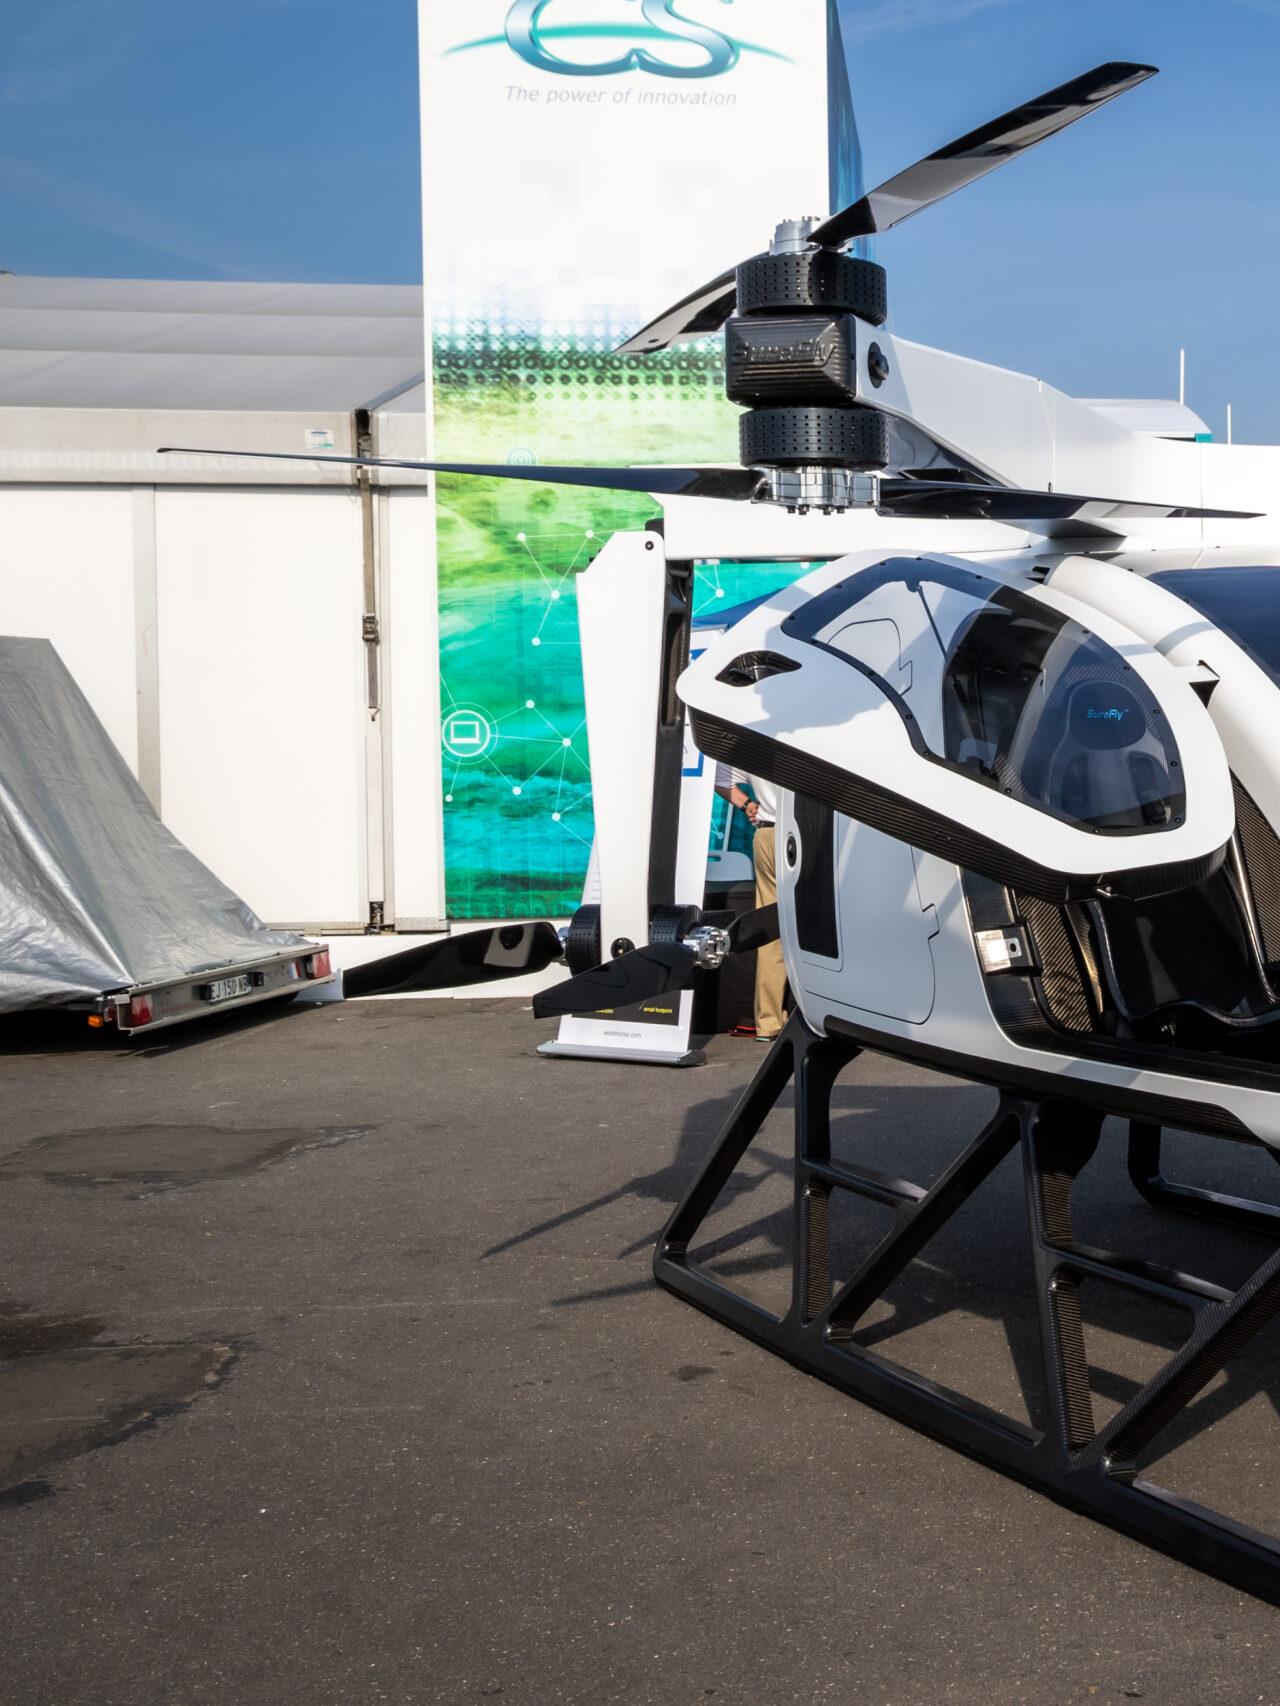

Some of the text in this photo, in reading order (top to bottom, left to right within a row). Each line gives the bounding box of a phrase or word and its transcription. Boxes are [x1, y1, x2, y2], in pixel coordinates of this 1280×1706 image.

[506, 85, 738, 106] The power of innovation
